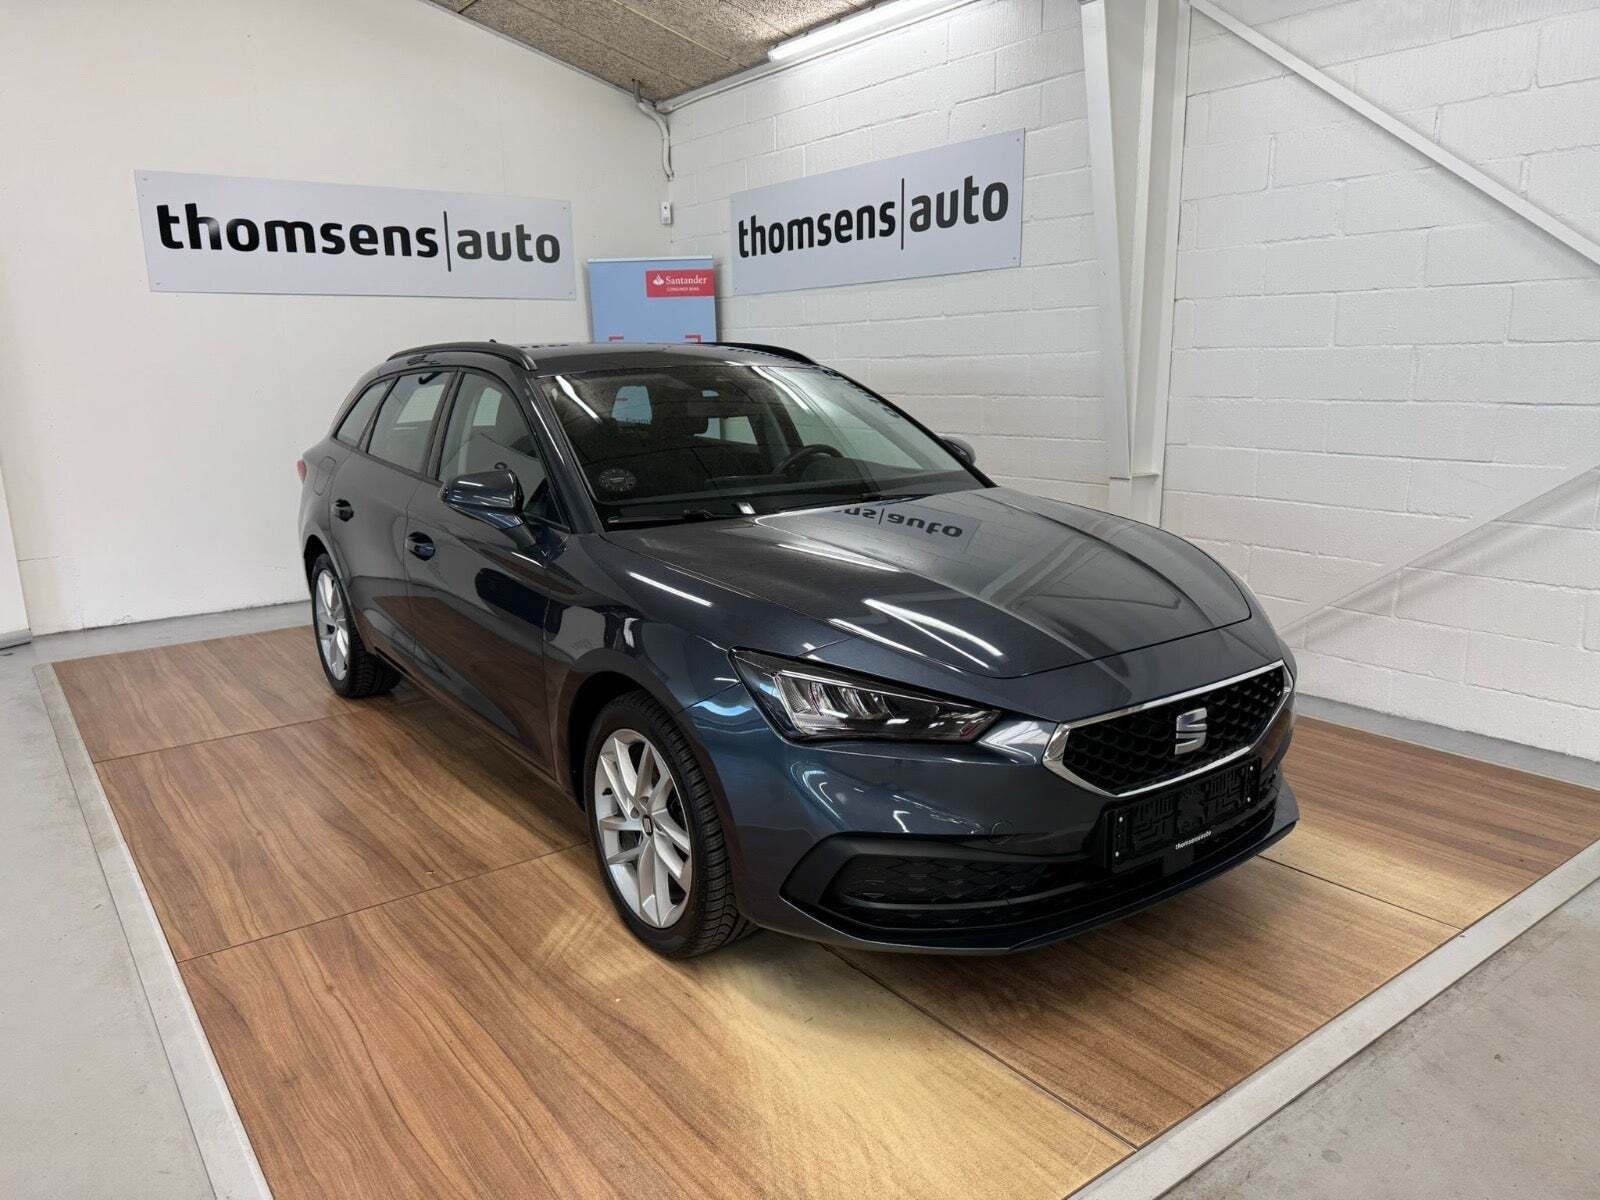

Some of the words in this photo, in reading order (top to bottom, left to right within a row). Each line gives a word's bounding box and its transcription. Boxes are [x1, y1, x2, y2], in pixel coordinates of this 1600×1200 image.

[156, 203, 439, 258] thomsens
[456, 224, 560, 263] auto
[738, 201, 896, 258] thomsens
[909, 175, 1009, 232] auto
[665, 274, 707, 286] Santander
